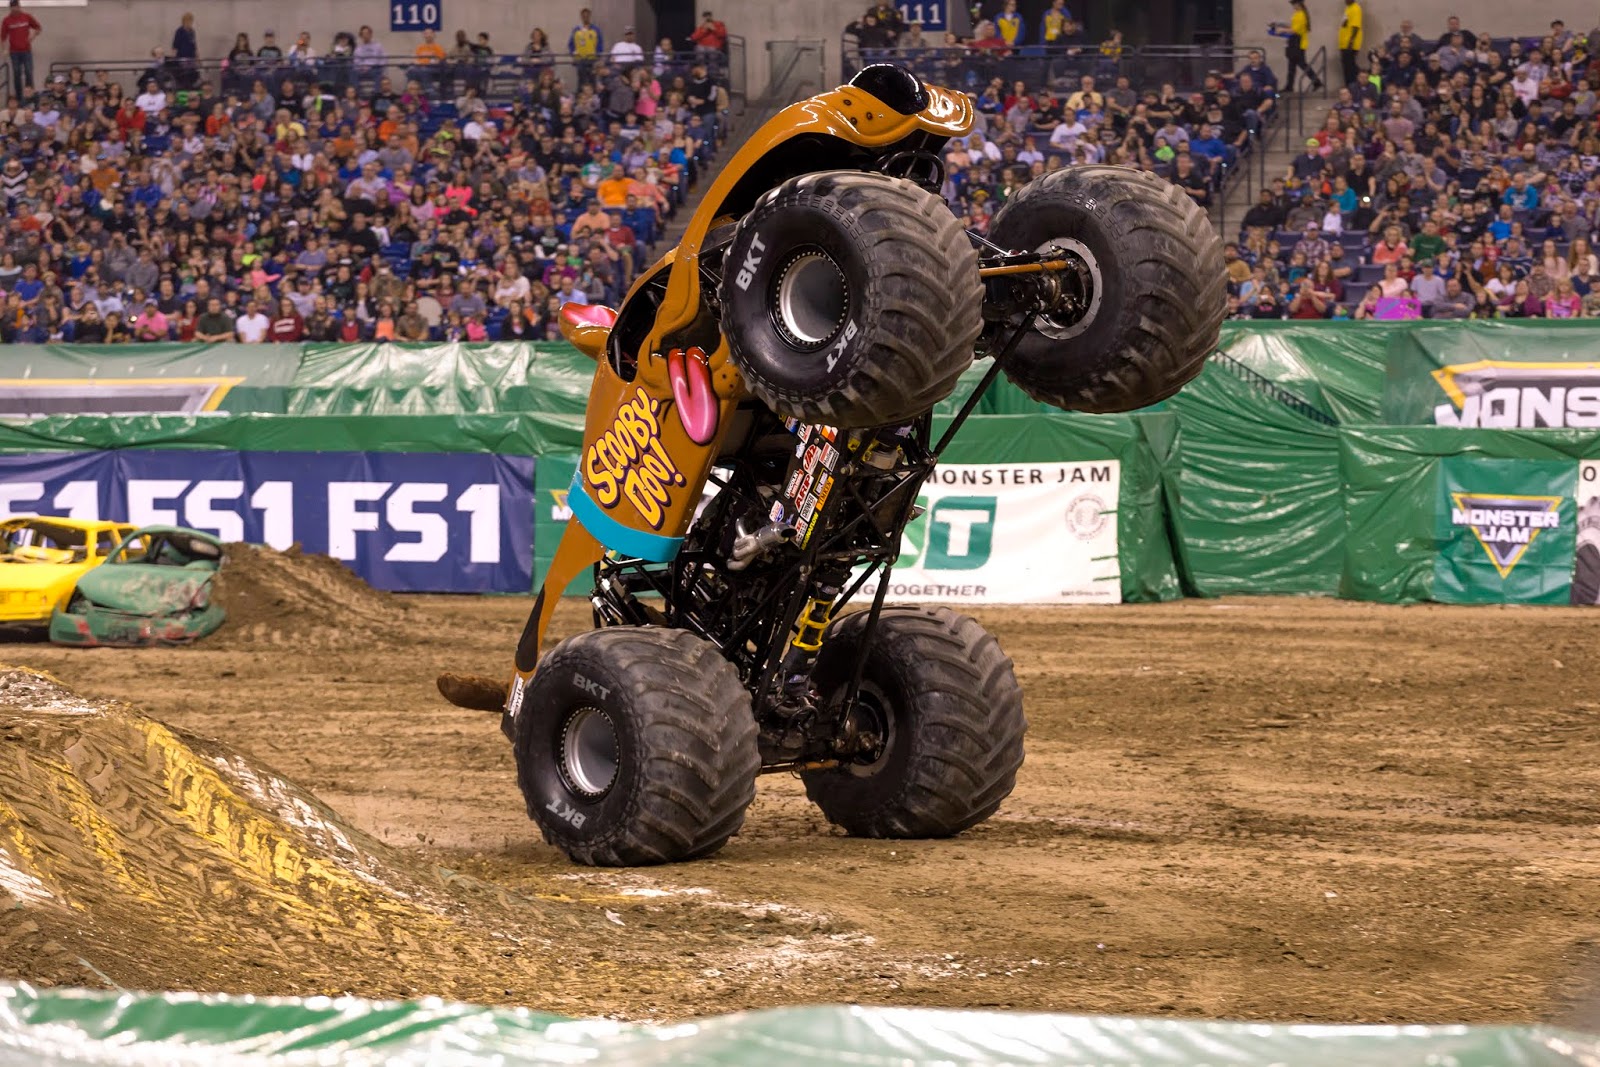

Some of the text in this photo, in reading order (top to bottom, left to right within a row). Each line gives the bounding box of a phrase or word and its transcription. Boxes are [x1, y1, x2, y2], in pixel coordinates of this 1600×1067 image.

[393, 4, 437, 24] 110
[900, 4, 942, 24] 111
[735, 232, 766, 291] BKT
[826, 319, 858, 374] BKT
[926, 466, 1111, 485] MONSTER JAM
[796, 474, 811, 510] ARP
[819, 481, 832, 506] TIMKEN
[127, 480, 293, 552] FS1
[328, 482, 500, 563] FS1
[1452, 508, 1560, 528] MONSTER
[1481, 526, 1530, 543] JAM
[573, 672, 610, 700] BKT
[546, 799, 587, 829] BKT
